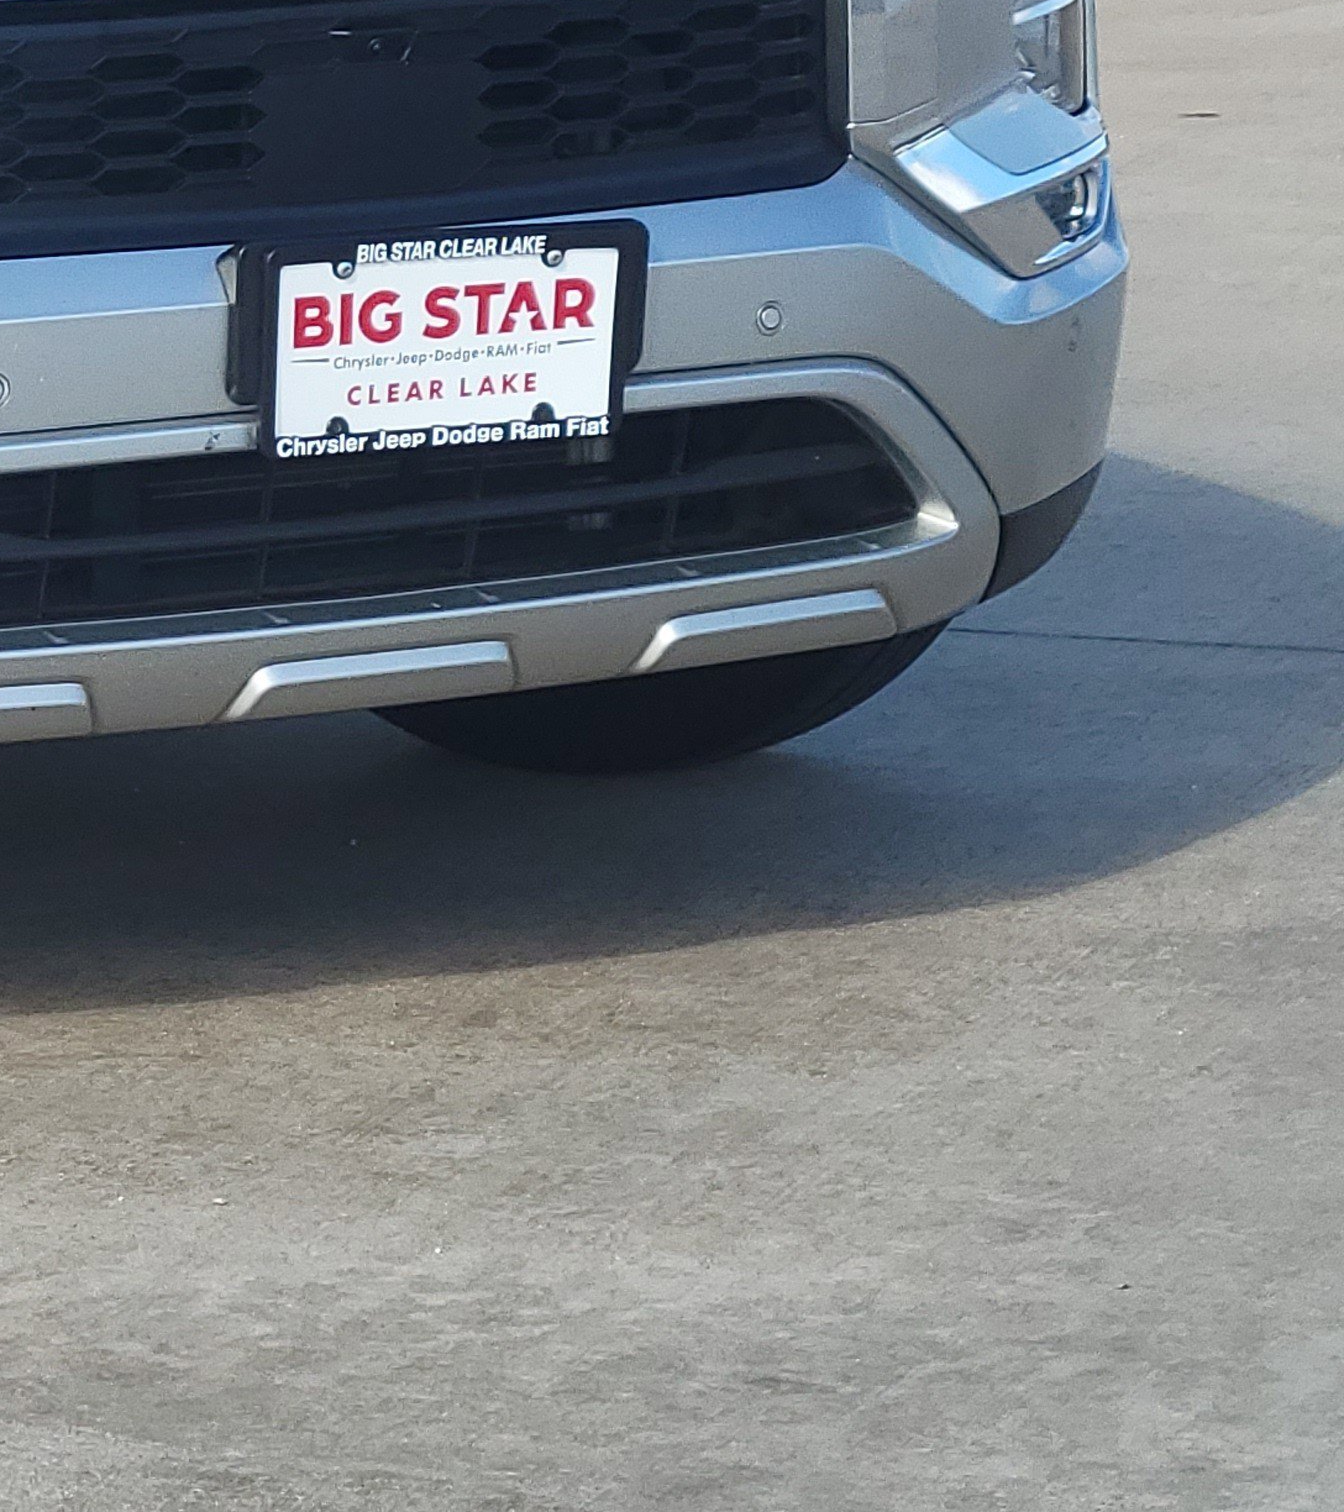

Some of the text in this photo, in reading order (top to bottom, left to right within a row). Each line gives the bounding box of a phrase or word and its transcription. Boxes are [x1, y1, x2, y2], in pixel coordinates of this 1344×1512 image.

[357, 234, 547, 264] BIG STAR CLEAR LAKE
[293, 278, 596, 350] BIG STAR
[347, 372, 538, 406] CLEAR LAKE
[276, 415, 610, 459] Chrysler Jeep Dodge Ram Fiat
